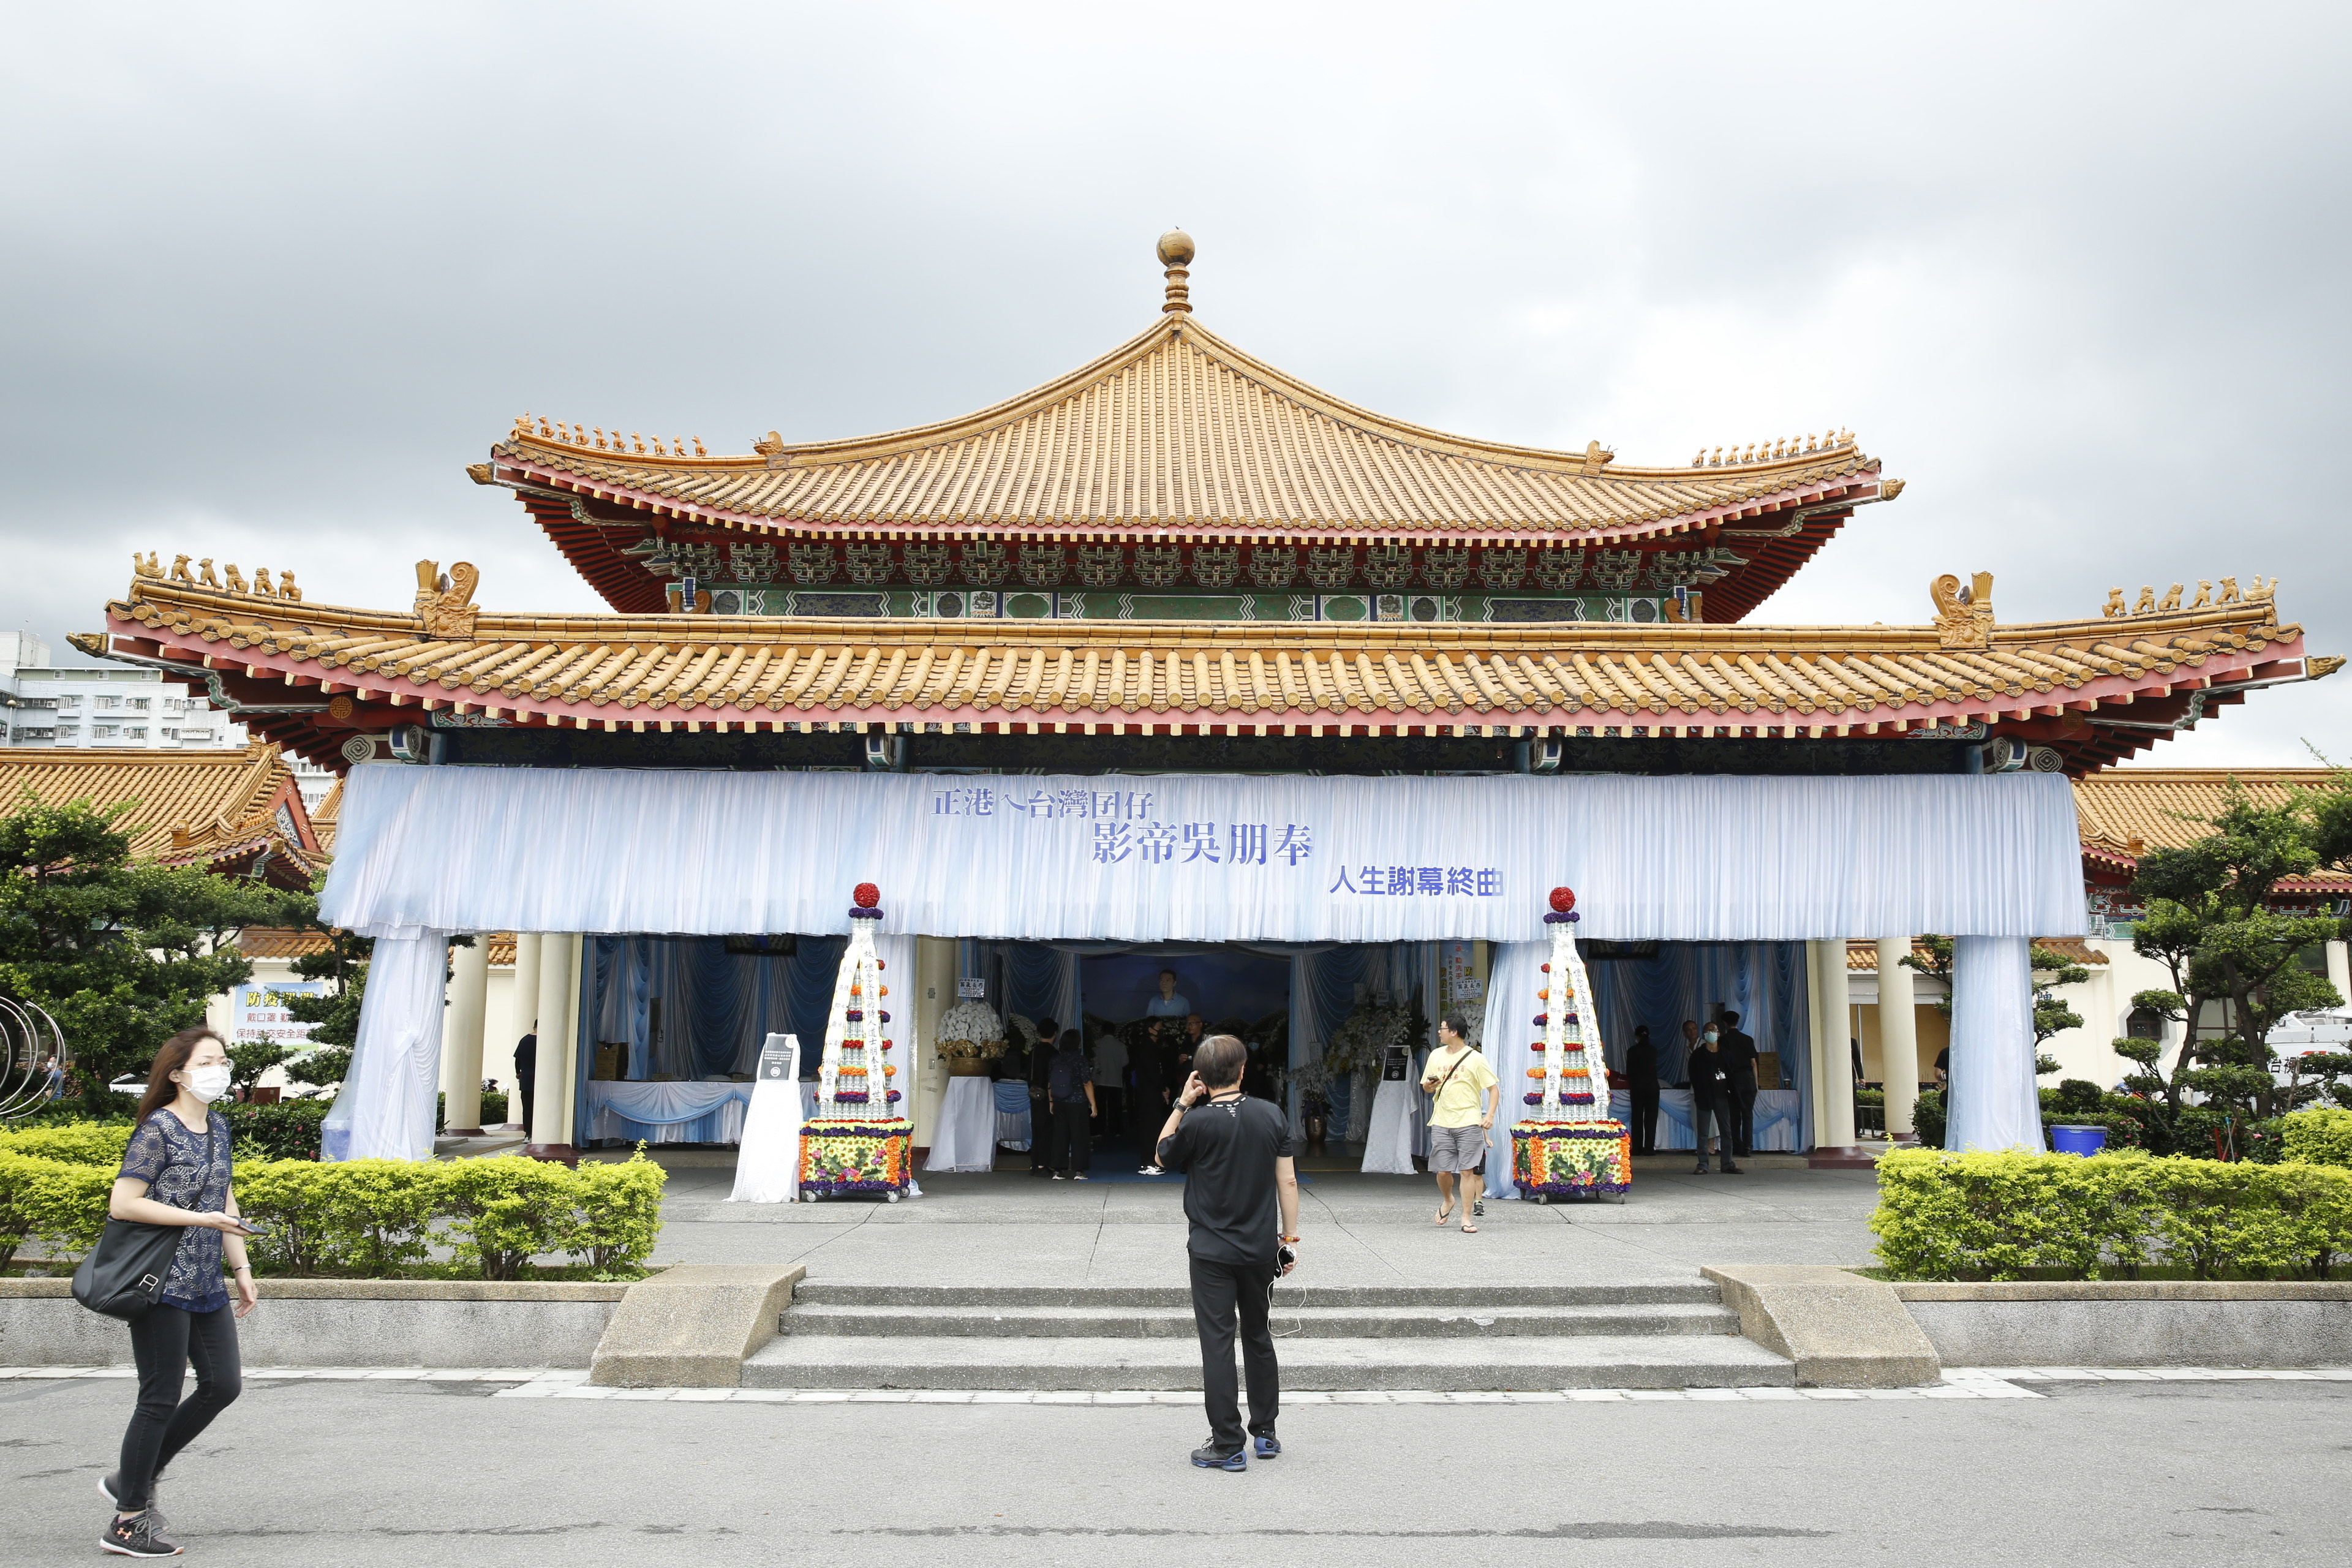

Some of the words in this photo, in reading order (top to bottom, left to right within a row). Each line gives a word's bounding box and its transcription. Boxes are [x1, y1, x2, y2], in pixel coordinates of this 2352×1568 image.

[1092, 821, 1313, 865] 影帝吳朋奉
[1330, 865, 1503, 897] 人生謝幕終曲
[247, 1012, 276, 1022] 戴口罩
[236, 1028, 312, 1039] 保持交安全距
